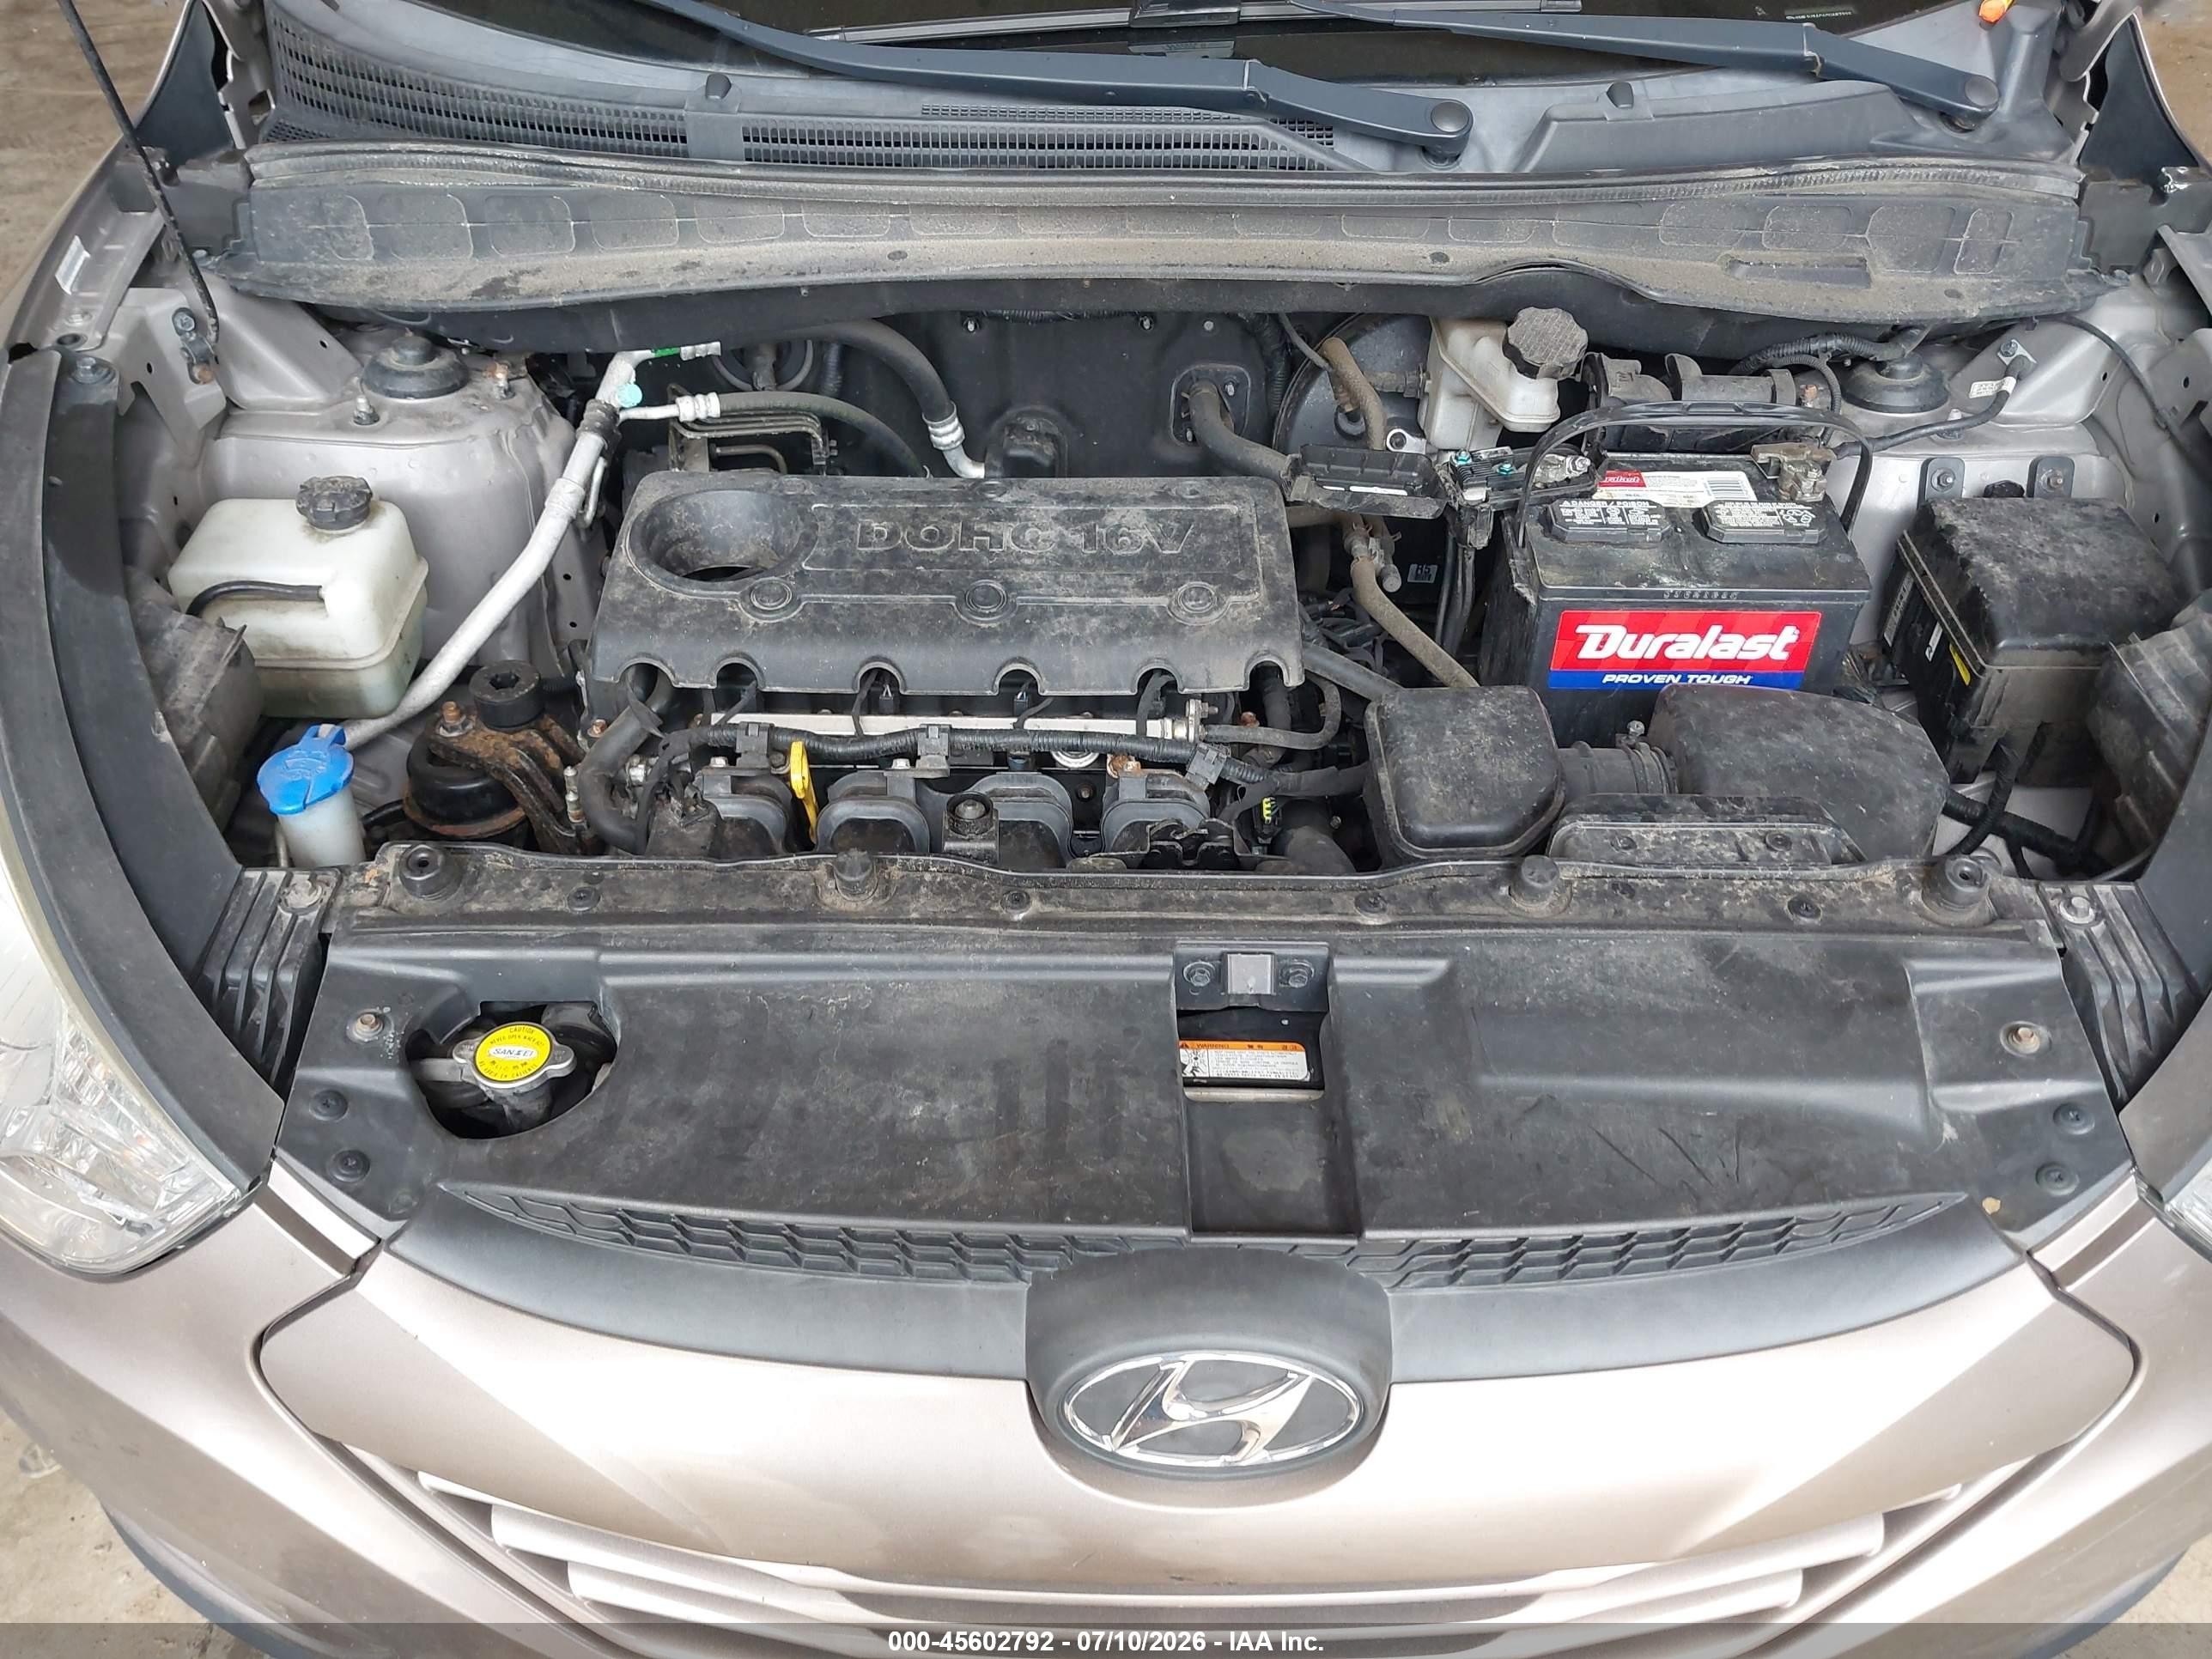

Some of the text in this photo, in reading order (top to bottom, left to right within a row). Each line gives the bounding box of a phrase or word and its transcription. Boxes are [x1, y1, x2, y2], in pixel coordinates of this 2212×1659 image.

[855, 520, 1194, 555] DOHC 16V
[1575, 624, 1800, 661] Duralast
[1602, 673, 1752, 685] PROVEN TOUGH
